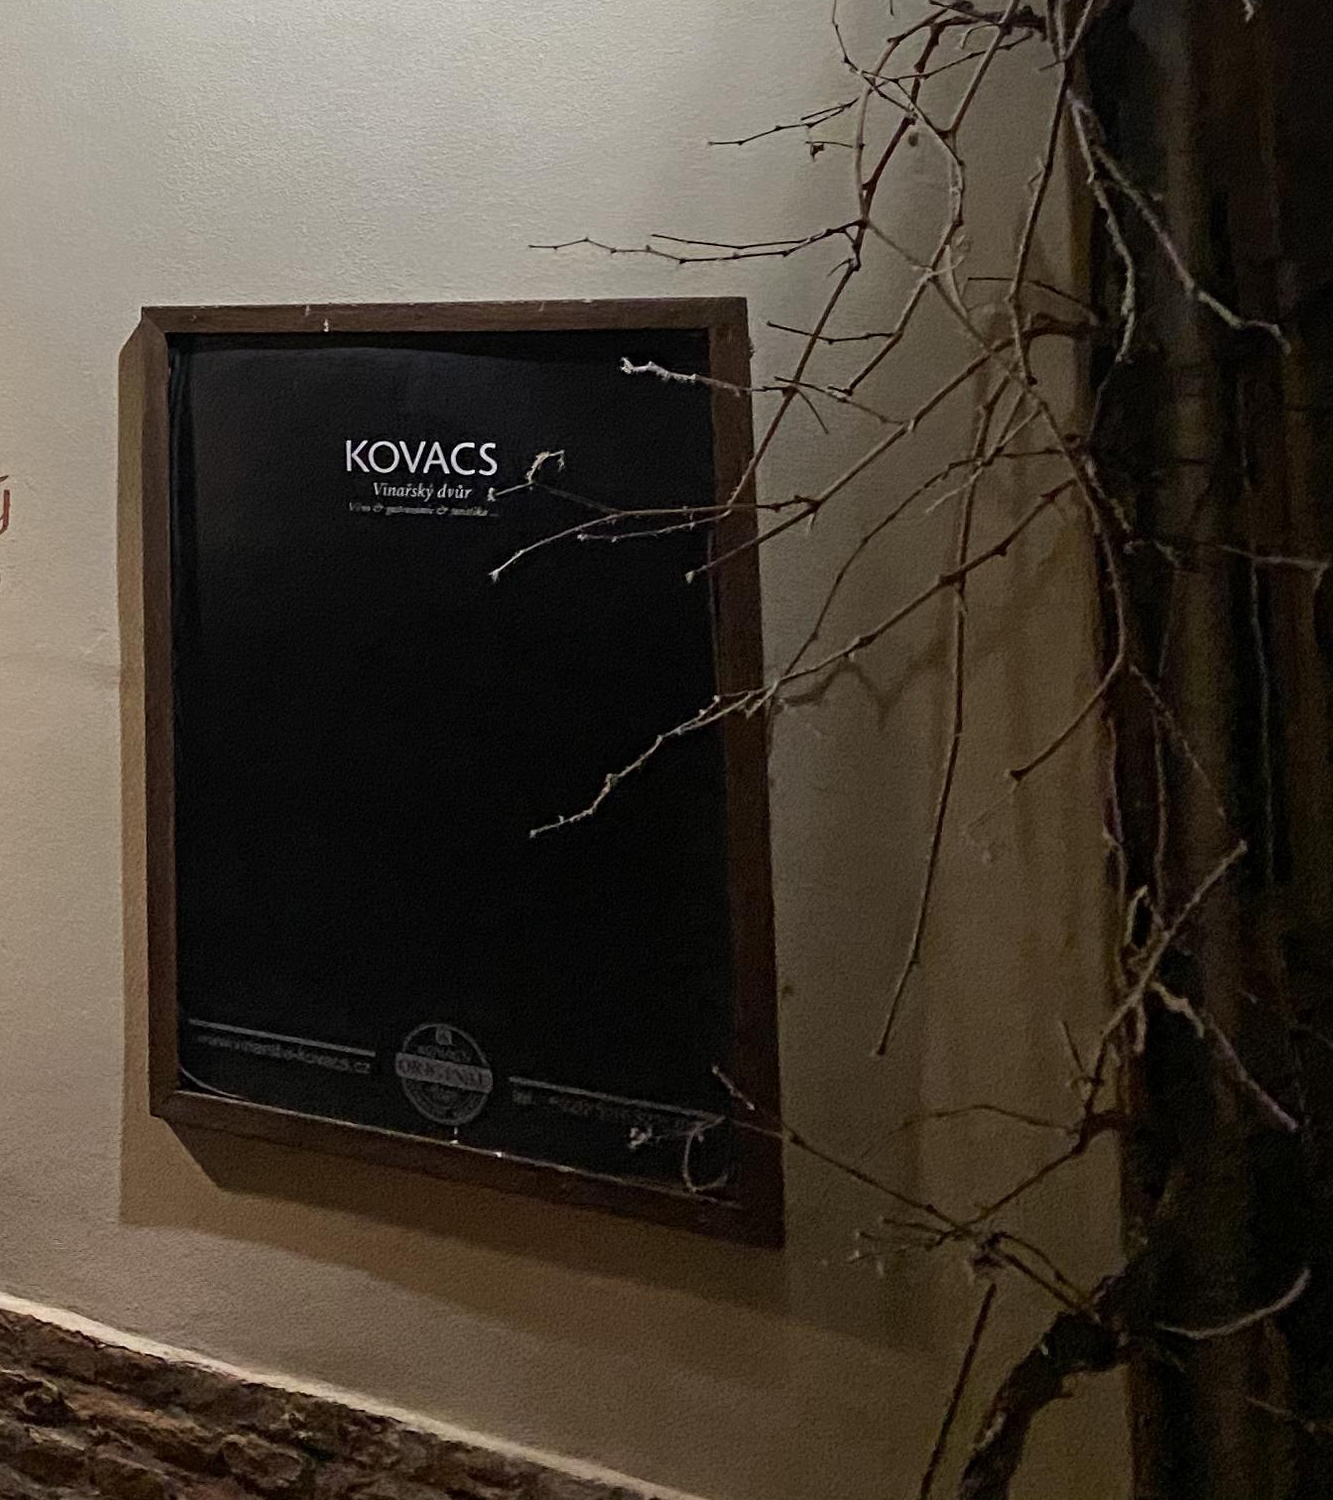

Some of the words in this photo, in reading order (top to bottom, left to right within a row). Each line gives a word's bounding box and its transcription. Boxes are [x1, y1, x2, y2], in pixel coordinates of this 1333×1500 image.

[344, 439, 499, 477] KOVACS
[372, 481, 435, 503] Vinařský
[436, 482, 473, 501] dvůr
